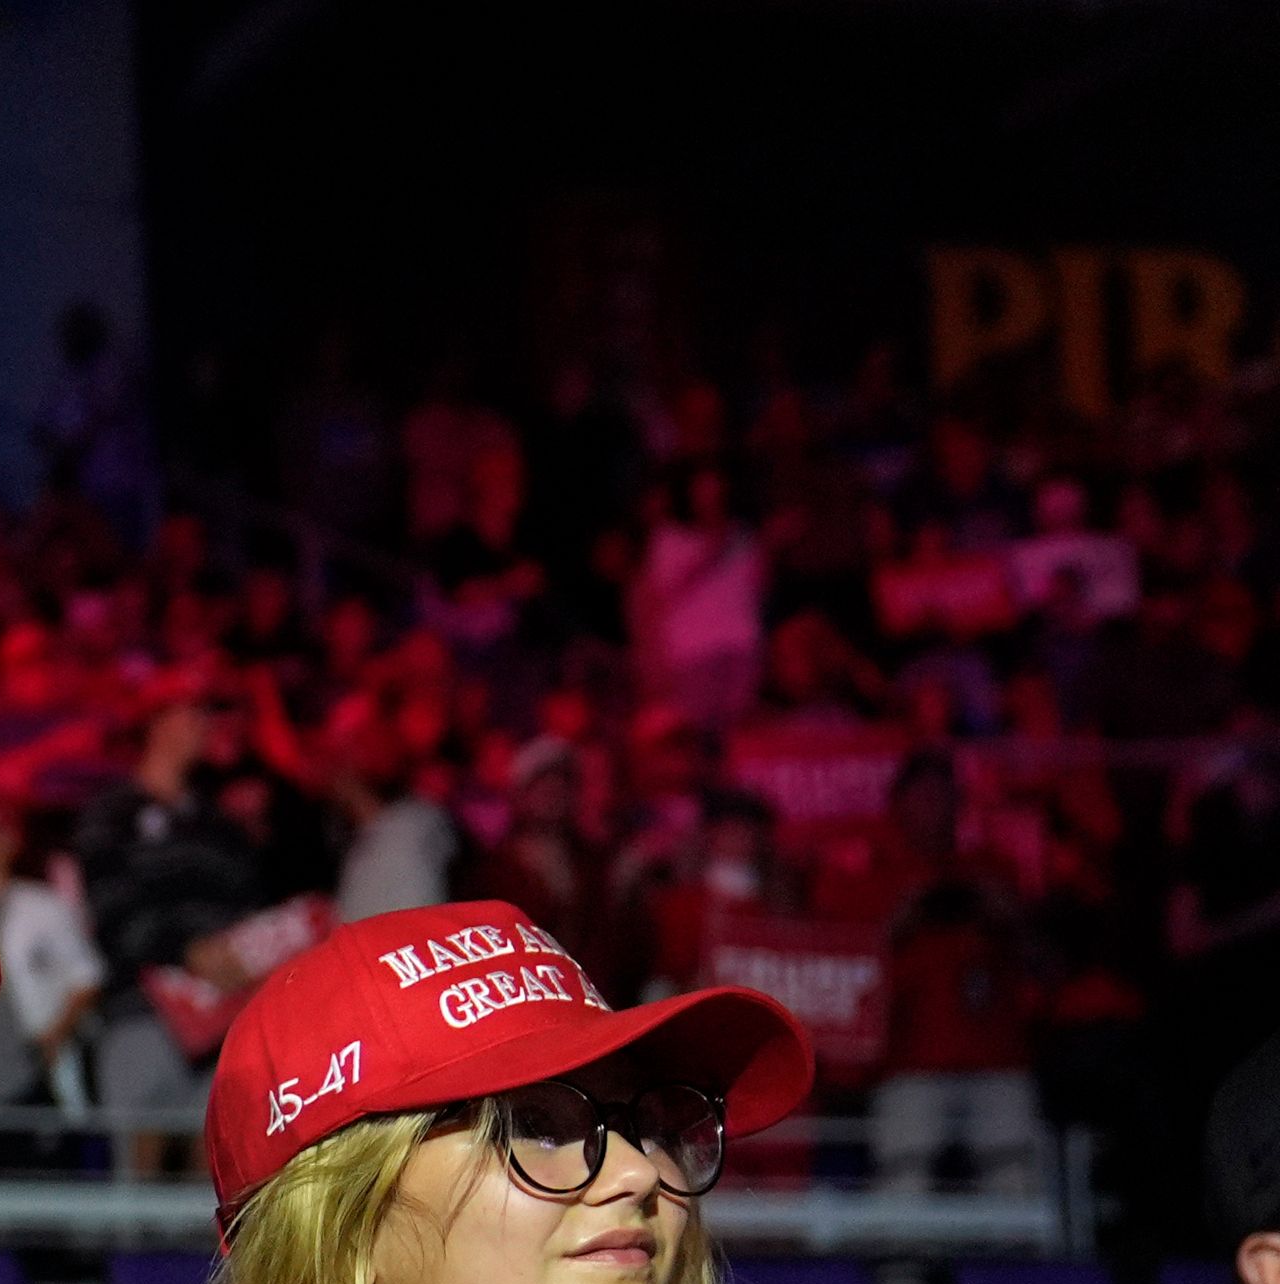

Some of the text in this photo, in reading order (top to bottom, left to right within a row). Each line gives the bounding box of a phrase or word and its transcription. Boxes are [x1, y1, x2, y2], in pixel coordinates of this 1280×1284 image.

[378, 923, 516, 990] MAKE
[439, 964, 573, 1029] GREAT
[265, 1040, 362, 1137] 45-47
